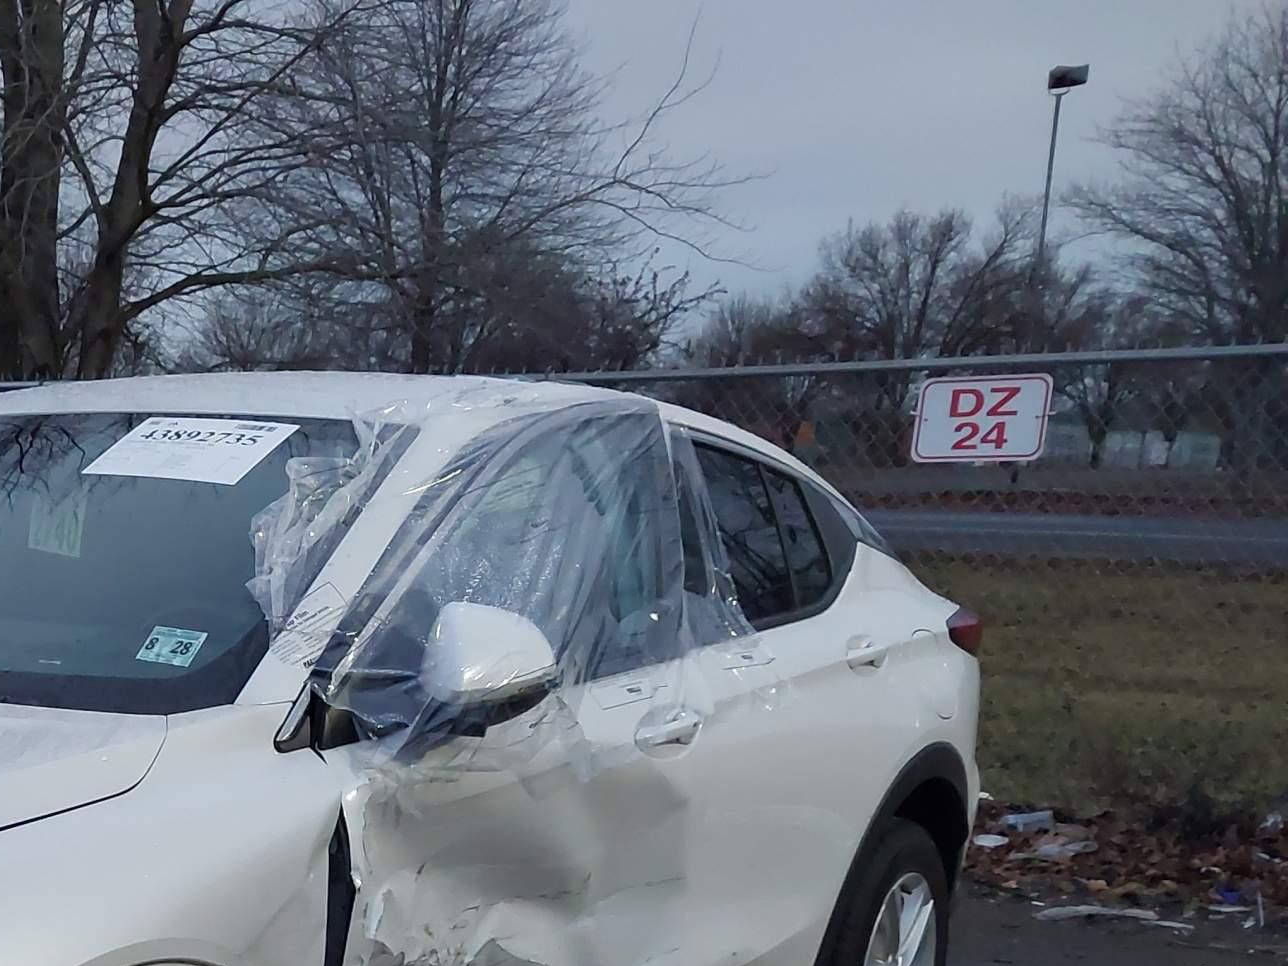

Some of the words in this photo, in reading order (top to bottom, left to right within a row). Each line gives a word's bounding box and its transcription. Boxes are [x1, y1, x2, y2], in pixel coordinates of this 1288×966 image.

[949, 386, 1022, 418] DZ
[139, 428, 264, 447] 43892735
[950, 421, 1008, 450] 24
[145, 637, 160, 651] 8
[169, 640, 193, 656] 28
